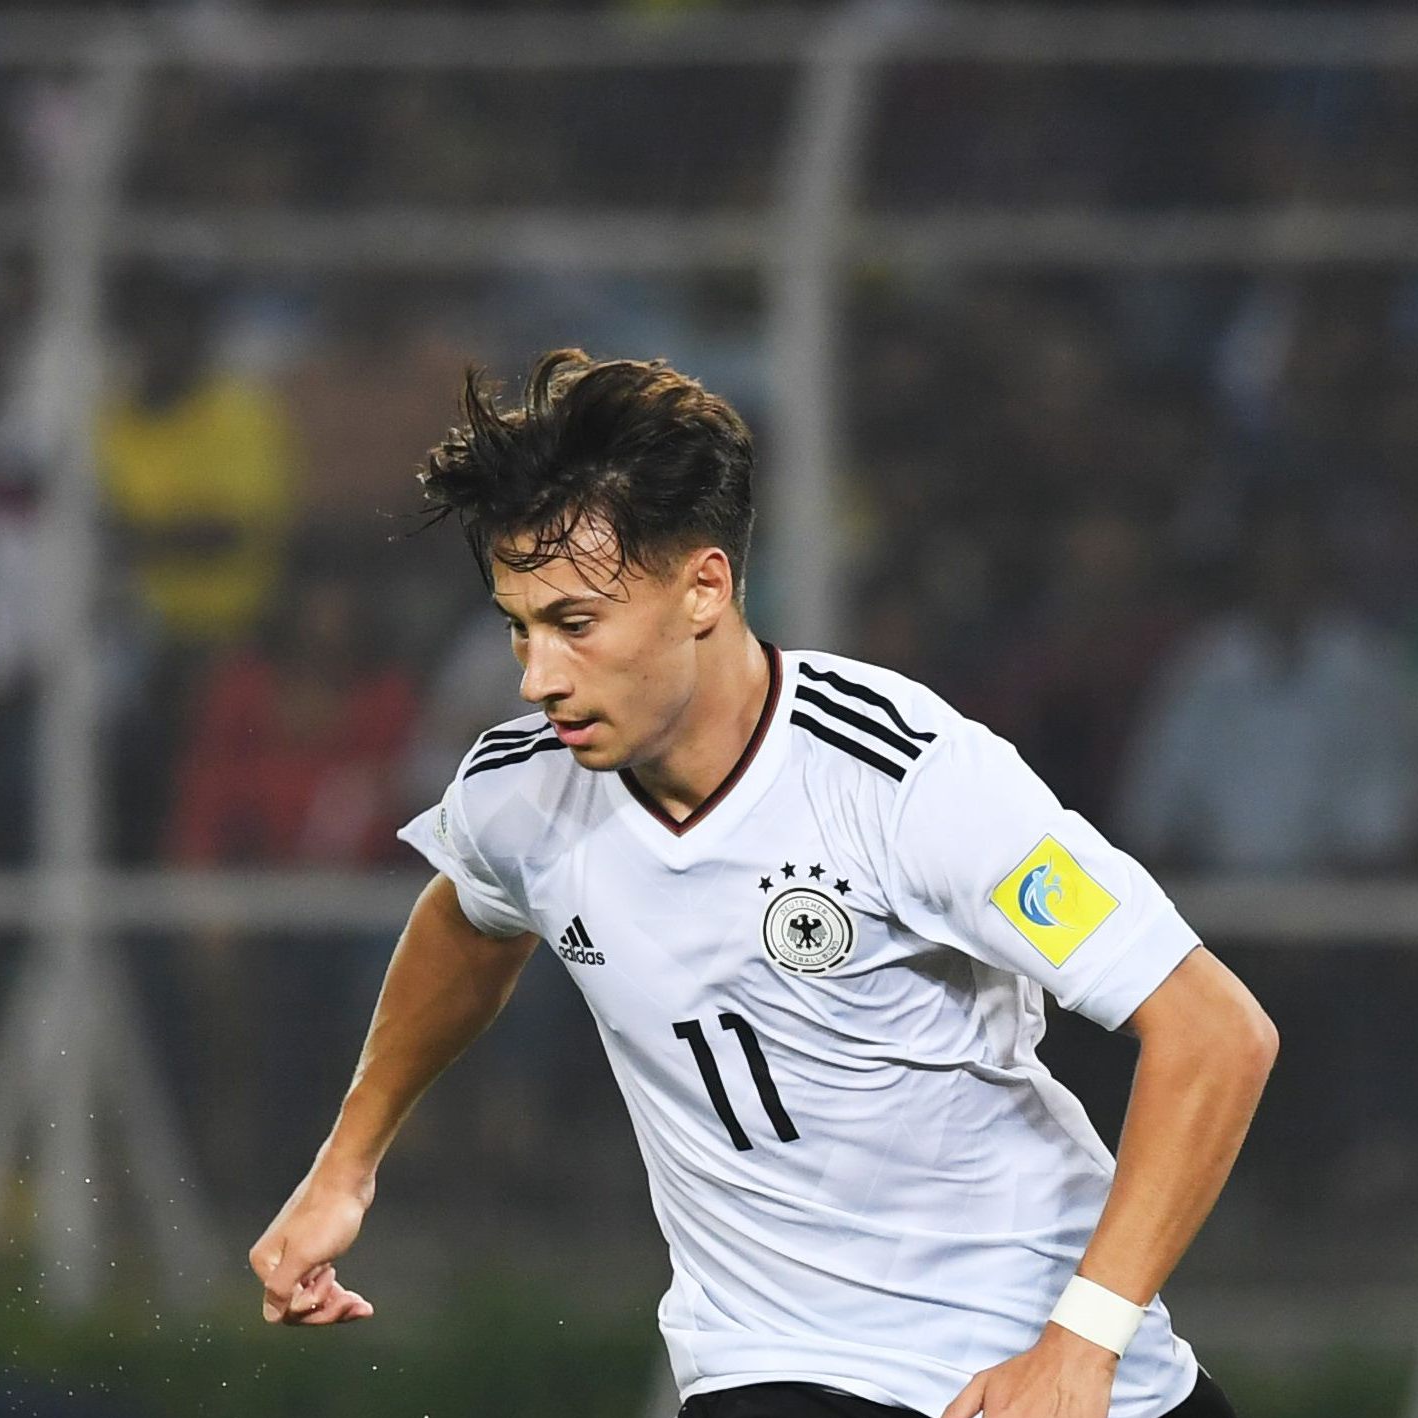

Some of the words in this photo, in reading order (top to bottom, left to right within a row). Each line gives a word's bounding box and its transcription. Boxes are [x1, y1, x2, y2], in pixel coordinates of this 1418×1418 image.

[779, 899, 828, 917] DEUTSCHER
[558, 944, 606, 966] adidas
[672, 1011, 800, 1152] 11
